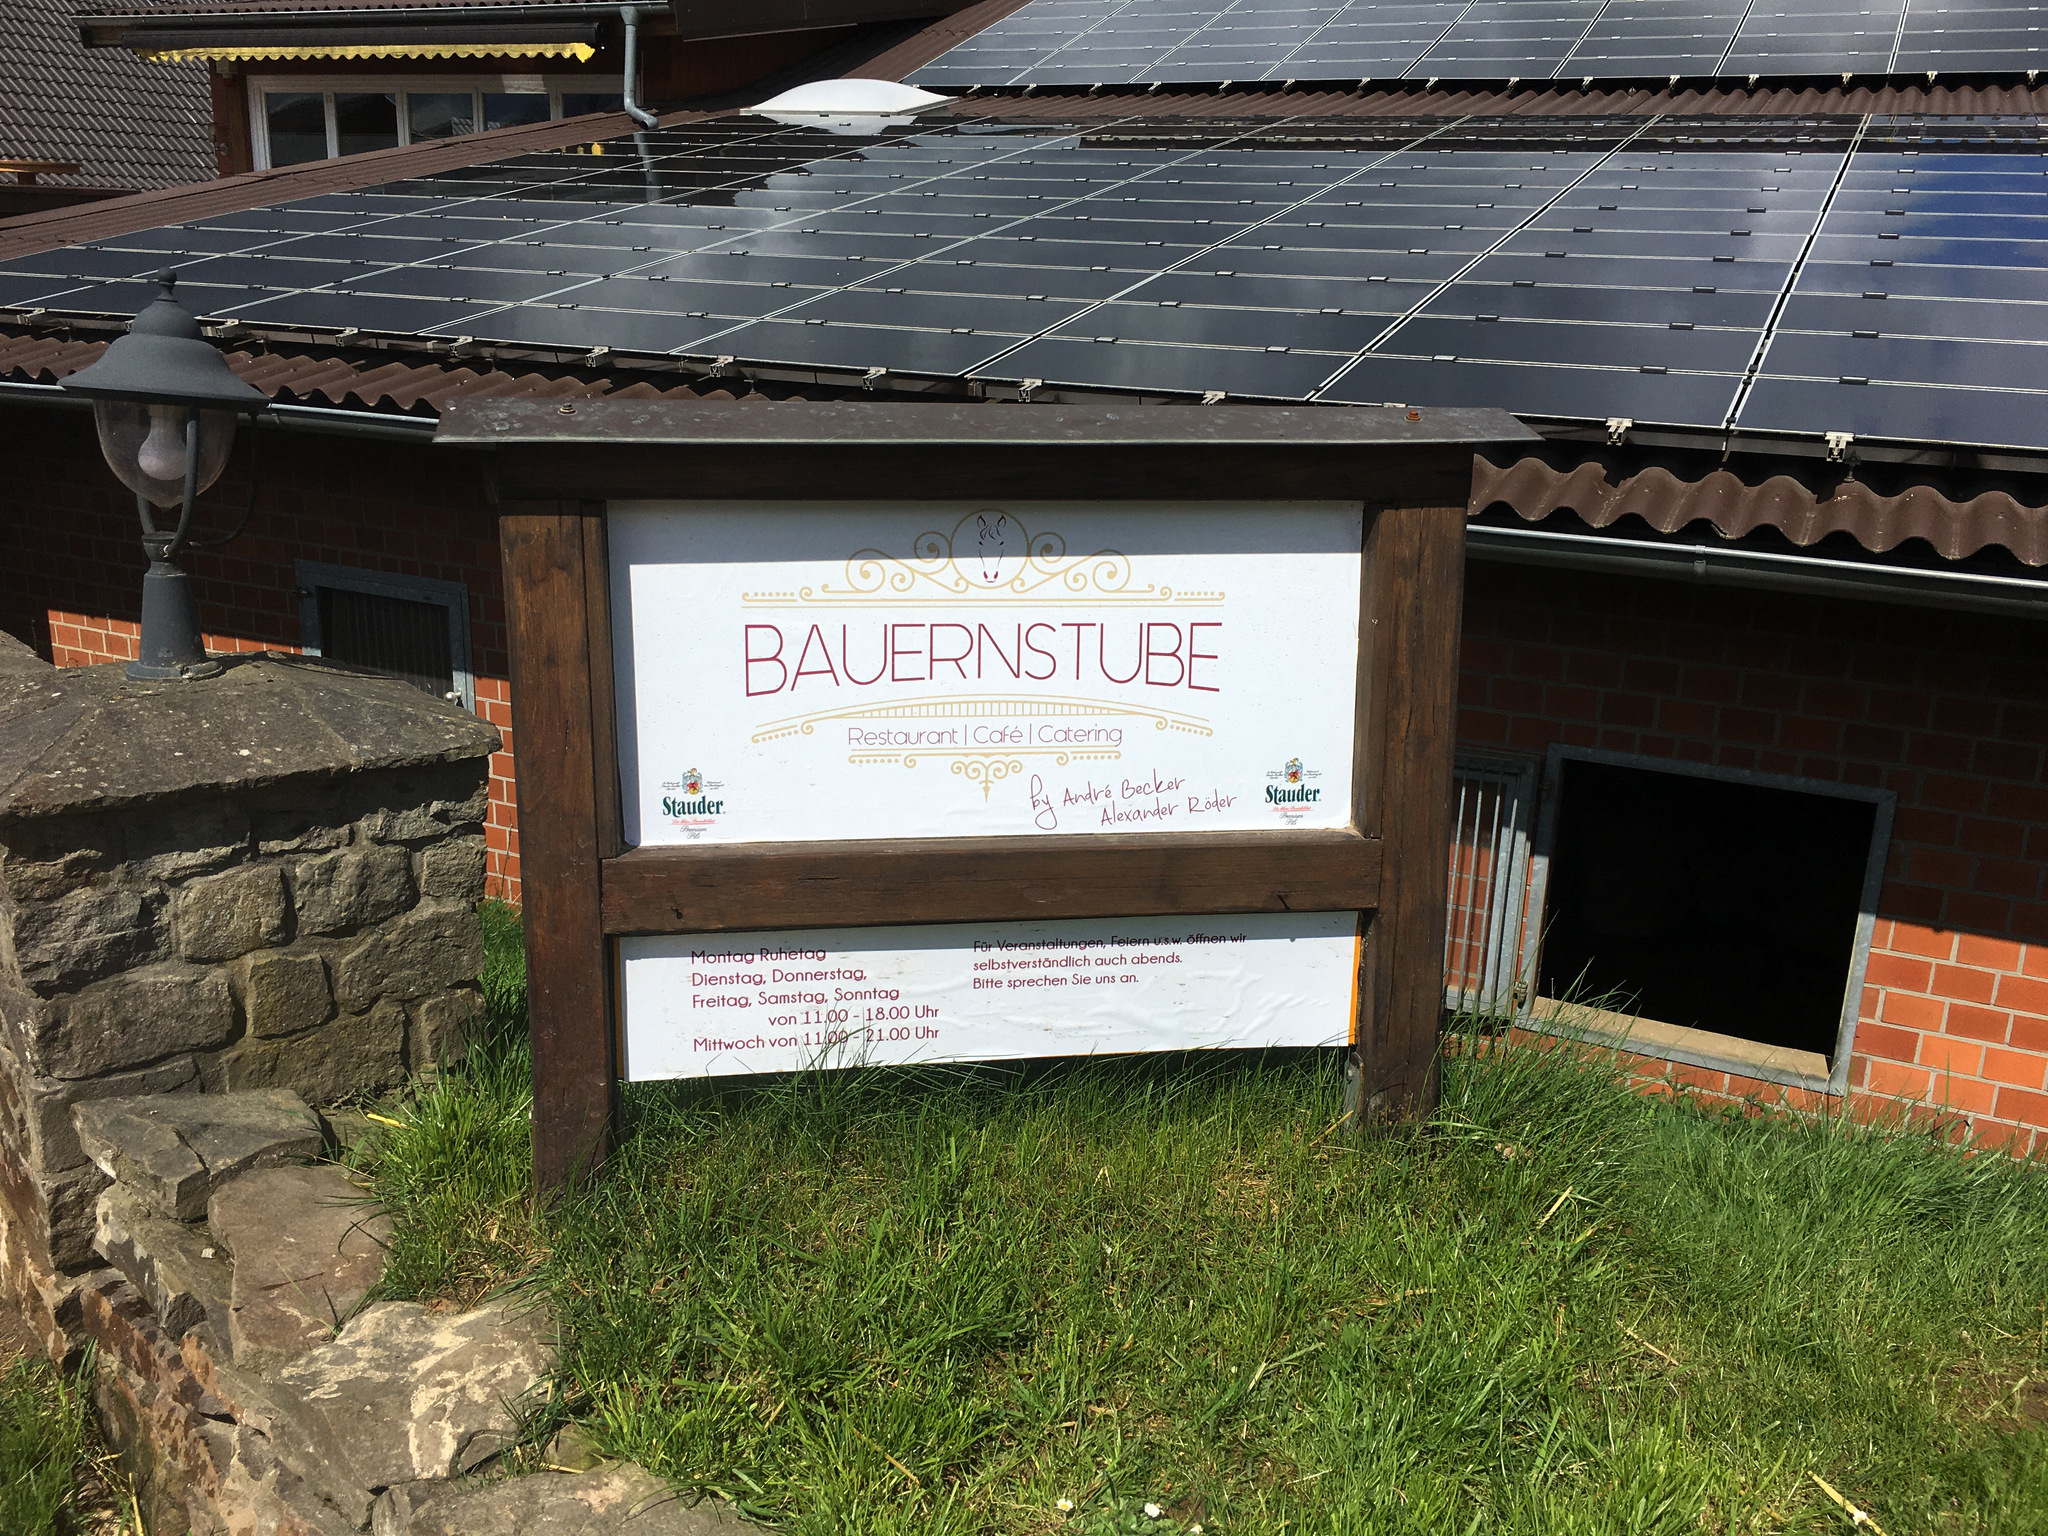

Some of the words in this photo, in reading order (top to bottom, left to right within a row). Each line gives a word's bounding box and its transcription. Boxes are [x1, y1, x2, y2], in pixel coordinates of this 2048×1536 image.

[744, 623, 1223, 697] BAUERNSTUBE
[848, 726, 958, 747] Restaurant
[973, 725, 1023, 744] Café
[1037, 723, 1123, 747] Catering
[1029, 774, 1058, 830] by
[1062, 780, 1113, 806] André
[1120, 768, 1186, 800] Becker
[1265, 783, 1320, 805] Stauder
[662, 795, 724, 818] Stauder
[1100, 798, 1179, 827] Alexander
[1188, 788, 1238, 814] Röder
[973, 940, 992, 953] Für
[997, 937, 1107, 952] Veranstaltungen,
[1111, 935, 1150, 948] Feiern
[1153, 936, 1183, 946] u.s.w.
[1186, 933, 1227, 945] öffnen
[1230, 933, 1247, 944] wir
[691, 949, 755, 965] Montag
[760, 947, 827, 962] Ruhetag
[973, 955, 1091, 972] selbstverständlich
[1094, 953, 1128, 968] auch
[1131, 951, 1183, 966] abends.
[692, 971, 767, 987] Dienstag,
[772, 967, 868, 984] Donnerstag,
[973, 977, 1004, 990] Bitte
[1007, 975, 1068, 990] sprechen
[1071, 973, 1092, 986] Sie
[1095, 973, 1116, 984] uns
[1120, 972, 1139, 984] an.
[692, 993, 752, 1009] Freitag,
[758, 989, 829, 1006] Samstag,
[834, 987, 900, 1002] Sonntag
[768, 1014, 797, 1027] von
[803, 1009, 848, 1025] 11.00
[866, 1005, 910, 1022] 18.00
[915, 1004, 939, 1020] Uhr
[693, 1034, 765, 1053] Mittwoch
[769, 1035, 798, 1048] von
[804, 1030, 848, 1046] 11.00
[866, 1026, 910, 1042] 21.00
[915, 1025, 939, 1040] Uhr
